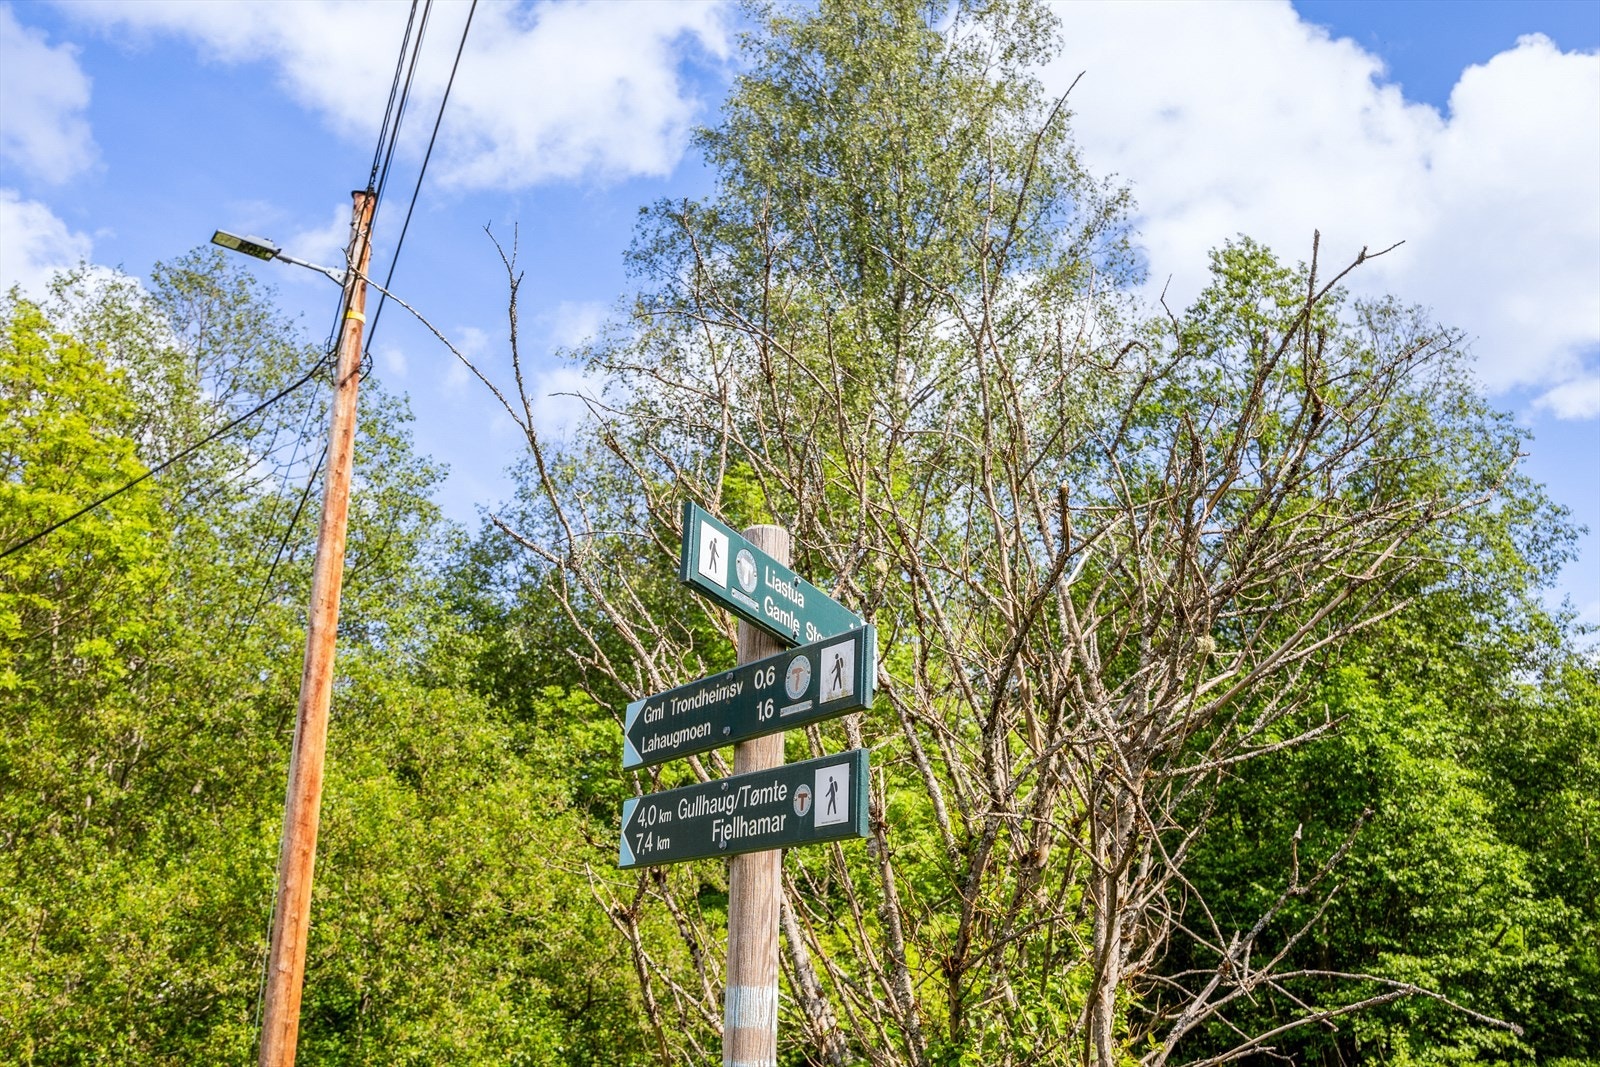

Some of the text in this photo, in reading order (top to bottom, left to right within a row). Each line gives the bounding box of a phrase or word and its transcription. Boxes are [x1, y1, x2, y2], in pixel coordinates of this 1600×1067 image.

[765, 565, 804, 608] Liastua
[764, 595, 800, 632] Gamle
[805, 621, 827, 643] Sto
[643, 706, 664, 724] Gml
[670, 679, 743, 716] Trondheimsv
[754, 665, 776, 690] 0,6
[641, 721, 711, 754] Lahaugmoen
[756, 698, 774, 722] 1,6
[637, 804, 657, 829] 4,0
[658, 808, 672, 823] km
[677, 779, 787, 820] Gullhaug/Tømte
[635, 813, 787, 855] 7,4 km Fjellhamar
